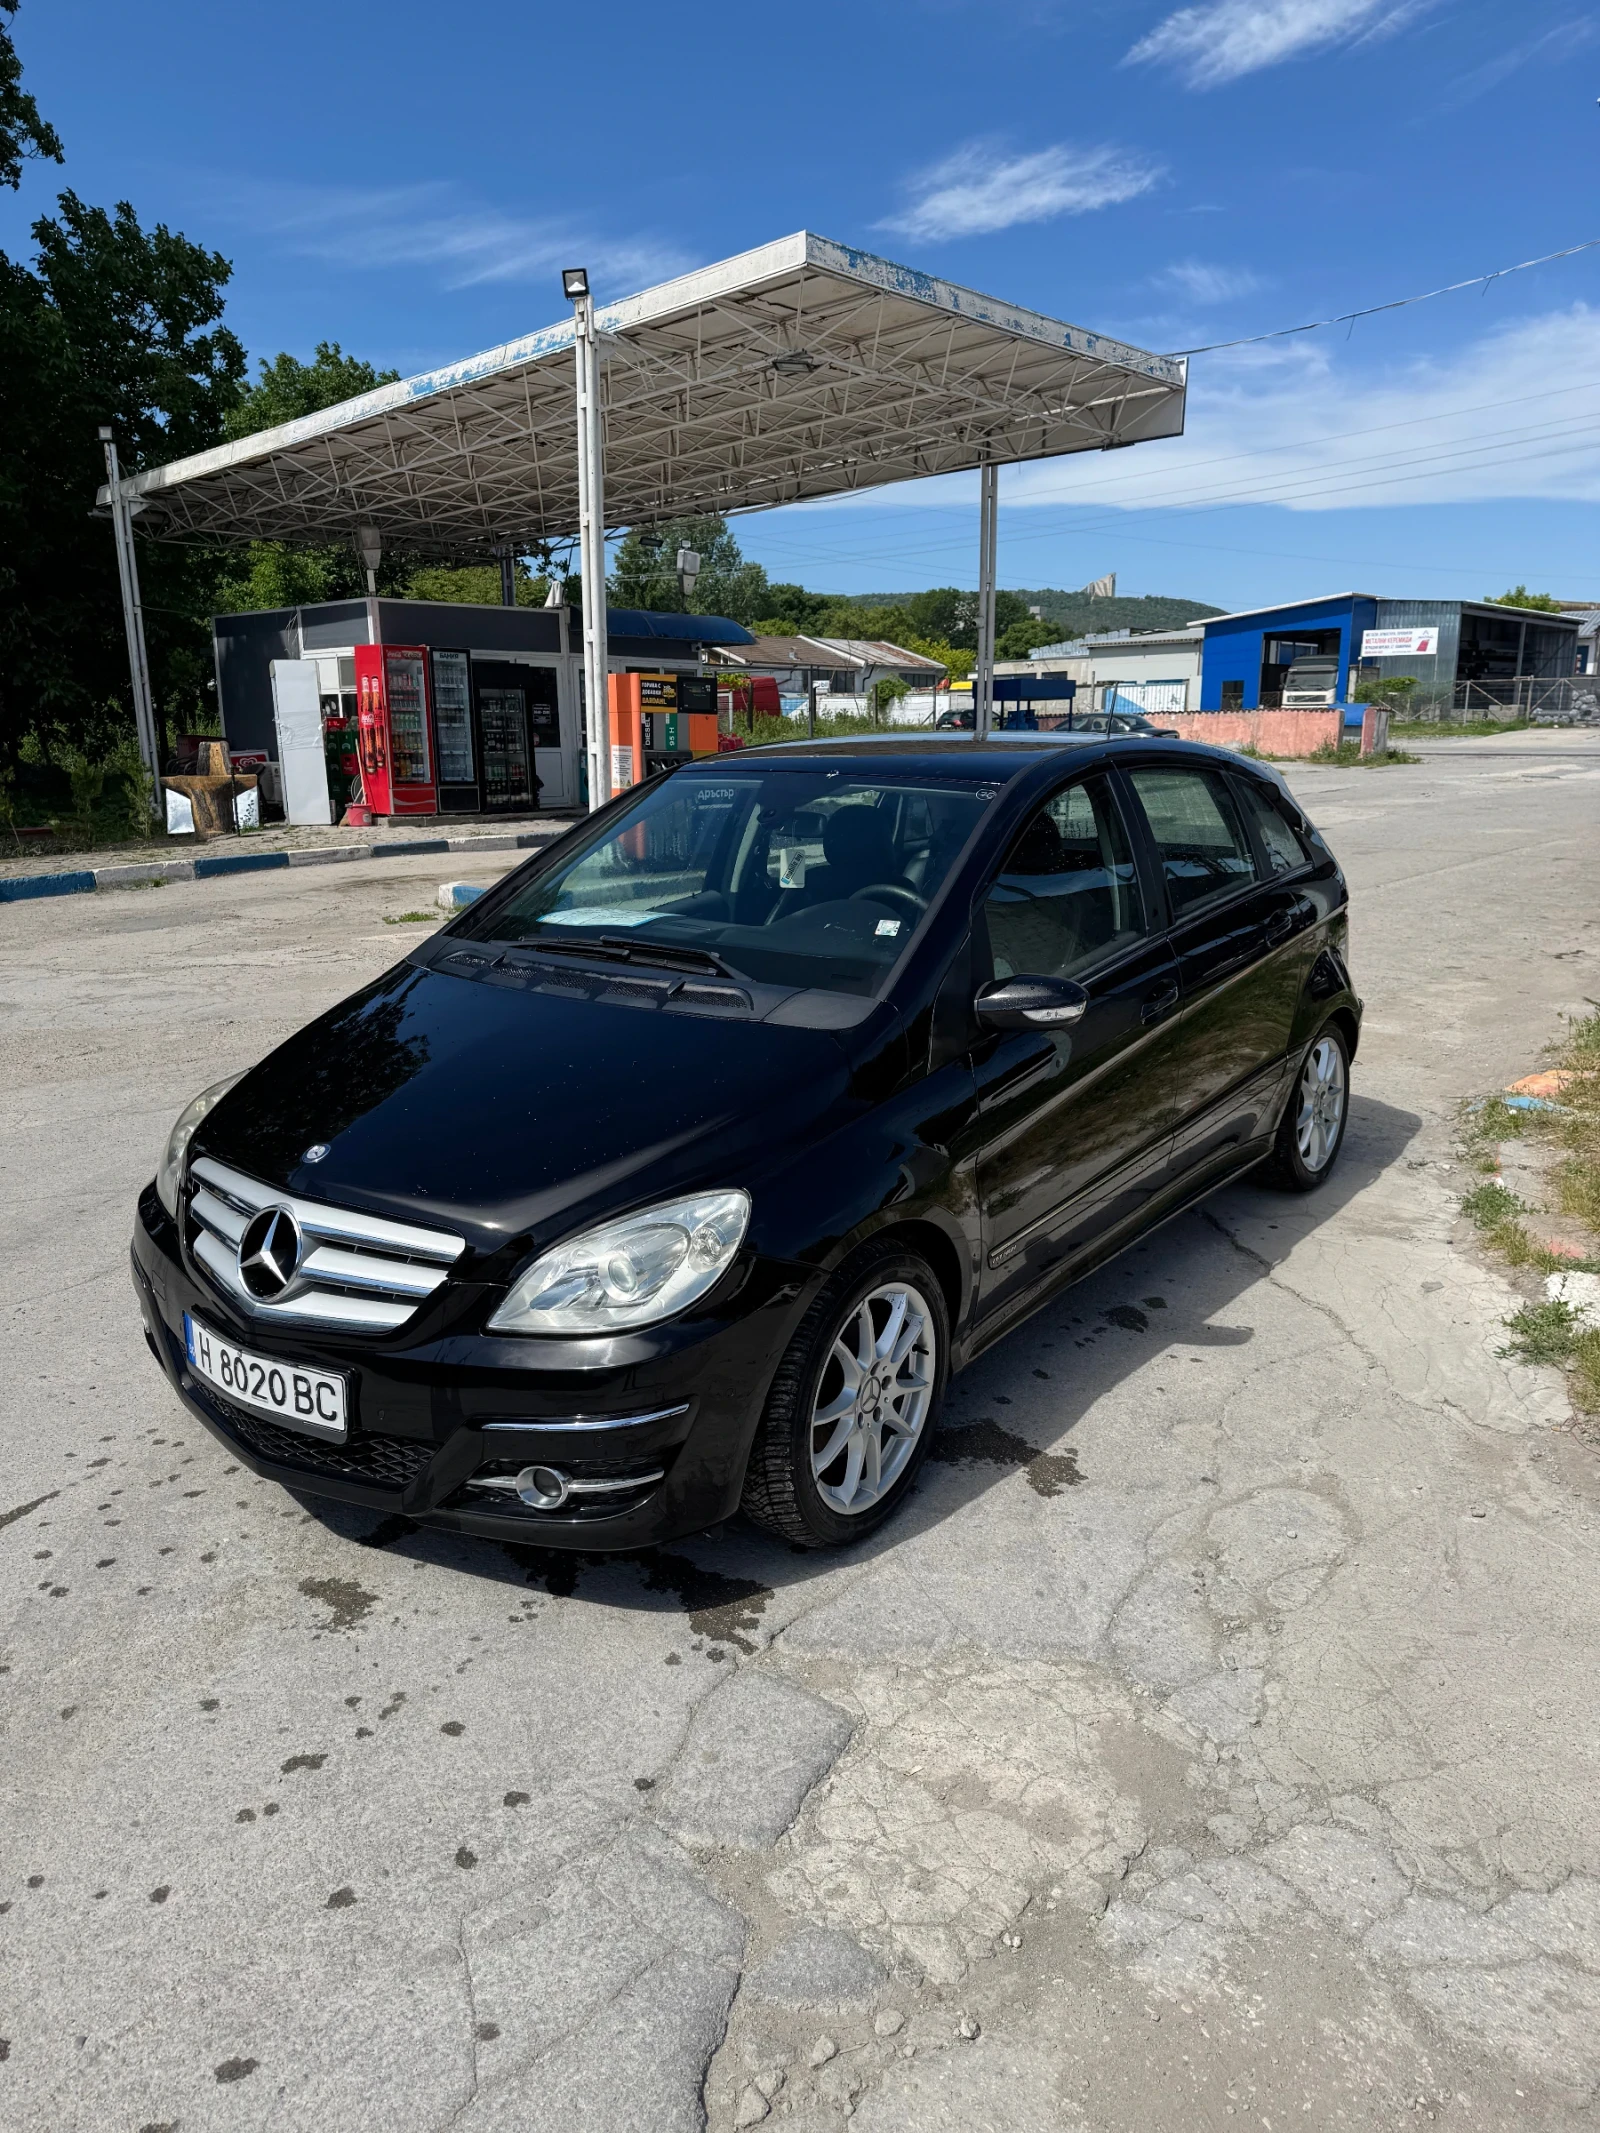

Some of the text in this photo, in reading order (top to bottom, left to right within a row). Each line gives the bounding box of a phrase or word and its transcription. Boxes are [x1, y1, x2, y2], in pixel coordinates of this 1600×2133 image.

[642, 697, 667, 705] BARDAHL
[669, 735, 675, 746] 95
[198, 1331, 213, 1375] H
